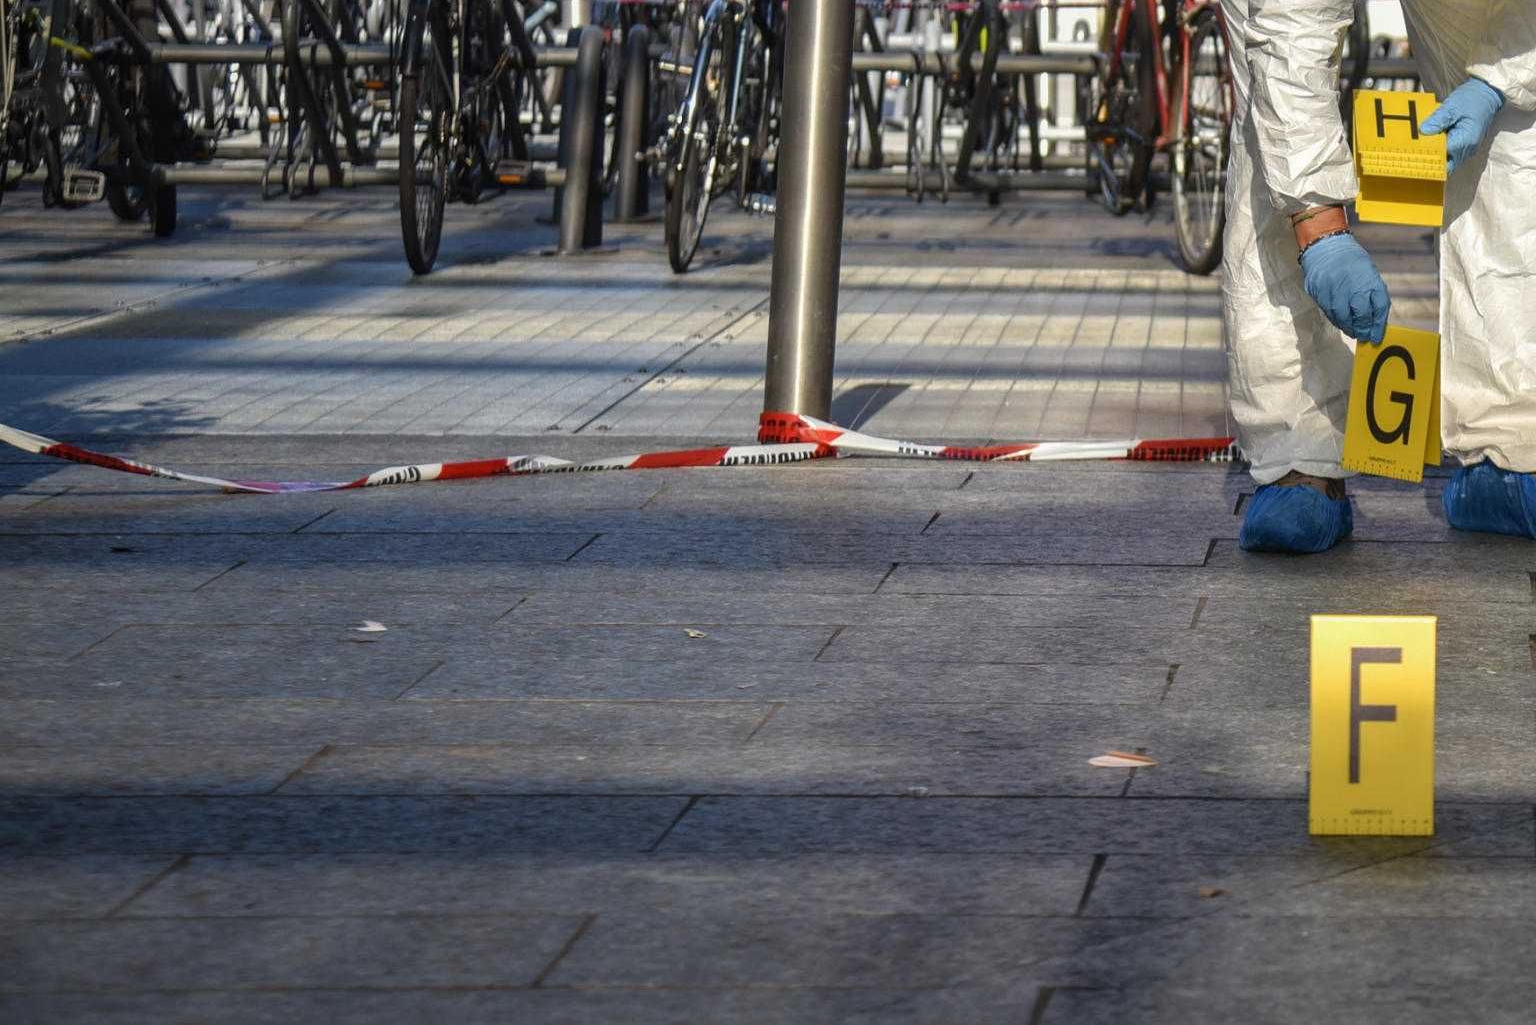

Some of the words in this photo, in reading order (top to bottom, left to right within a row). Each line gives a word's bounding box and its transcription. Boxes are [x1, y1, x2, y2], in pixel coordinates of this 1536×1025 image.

[1374, 98, 1419, 140] H
[1365, 345, 1416, 446] G
[1348, 647, 1403, 784] F
